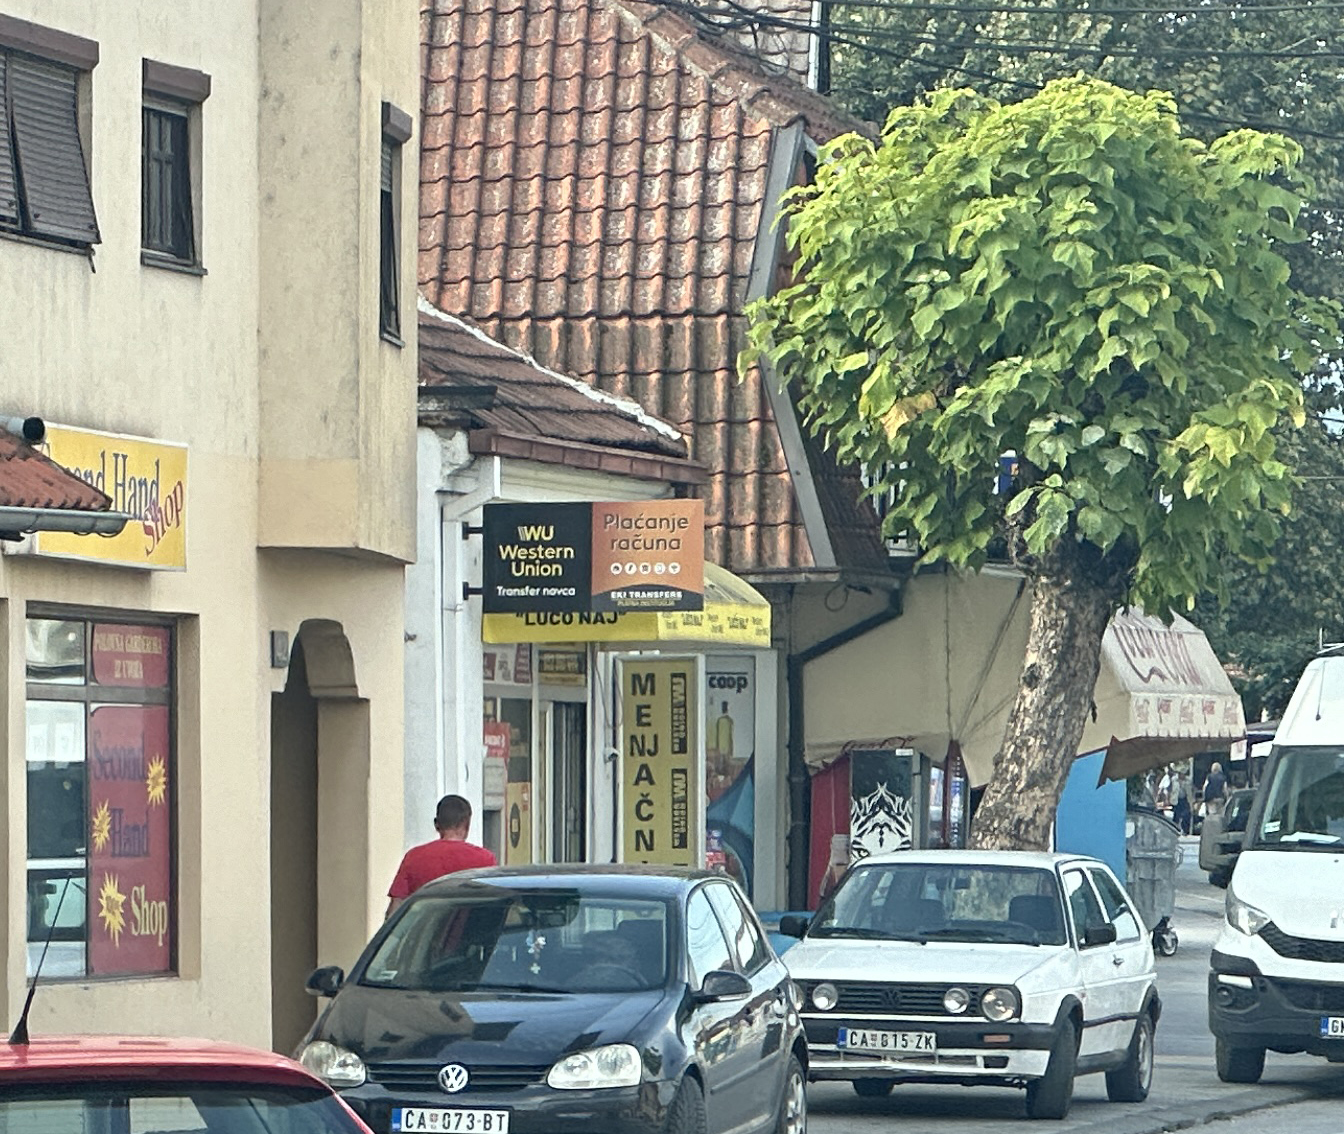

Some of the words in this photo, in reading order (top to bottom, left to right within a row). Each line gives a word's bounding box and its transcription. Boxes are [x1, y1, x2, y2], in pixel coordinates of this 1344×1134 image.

[112, 453, 160, 523] Hand
[603, 513, 689, 533] Plaćanje
[611, 533, 681, 551] računa
[499, 545, 574, 560] Western
[511, 560, 563, 576] Union
[496, 585, 540, 597] Transfer
[708, 674, 749, 694] coop
[111, 808, 150, 858] Hand
[130, 884, 168, 947] Shop
